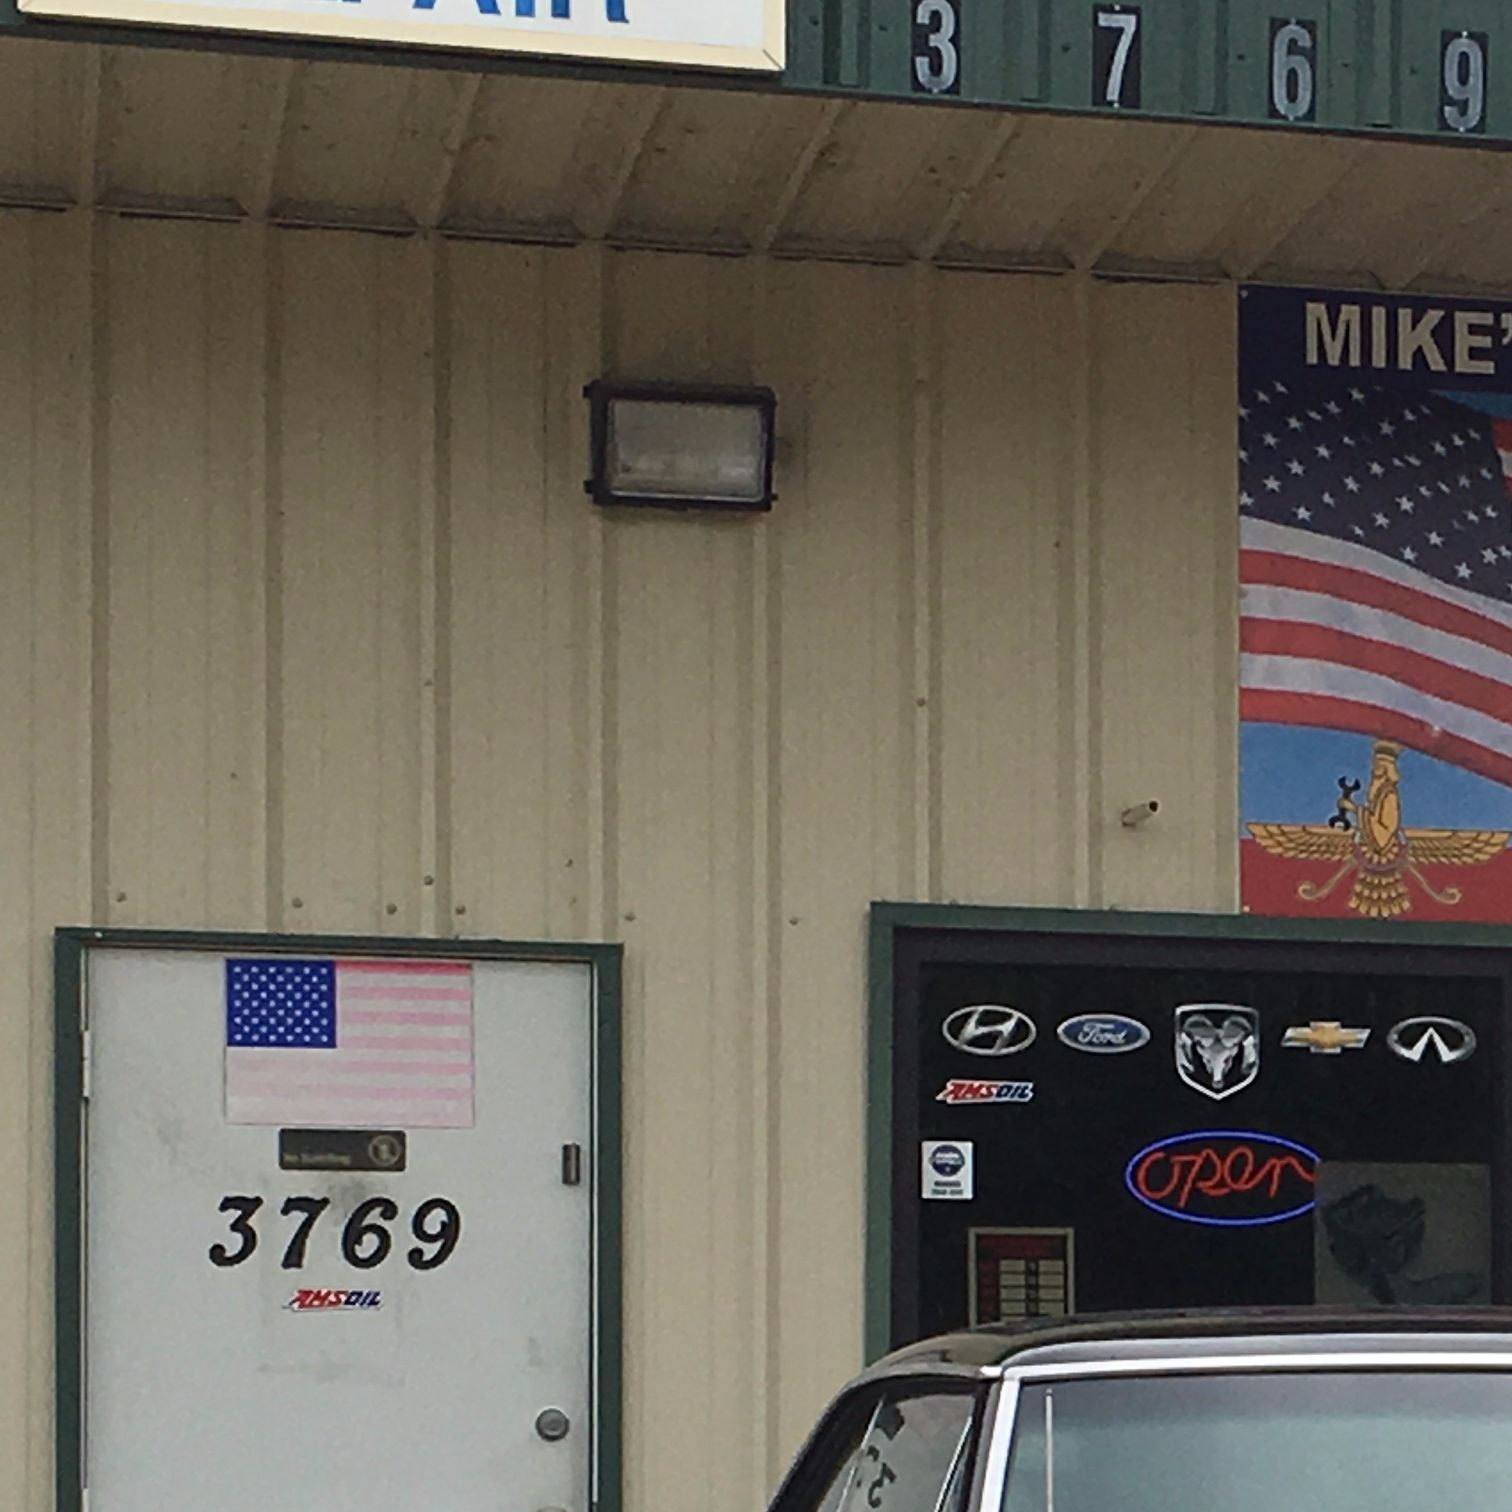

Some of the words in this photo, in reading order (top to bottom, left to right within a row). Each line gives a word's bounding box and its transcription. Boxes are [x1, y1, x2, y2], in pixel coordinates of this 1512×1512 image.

[1078, 1021, 1128, 1044] Ford
[940, 1080, 1032, 1104] AMSOIL
[208, 1195, 461, 1271] 3769
[288, 1288, 382, 1310] AMSOIL
